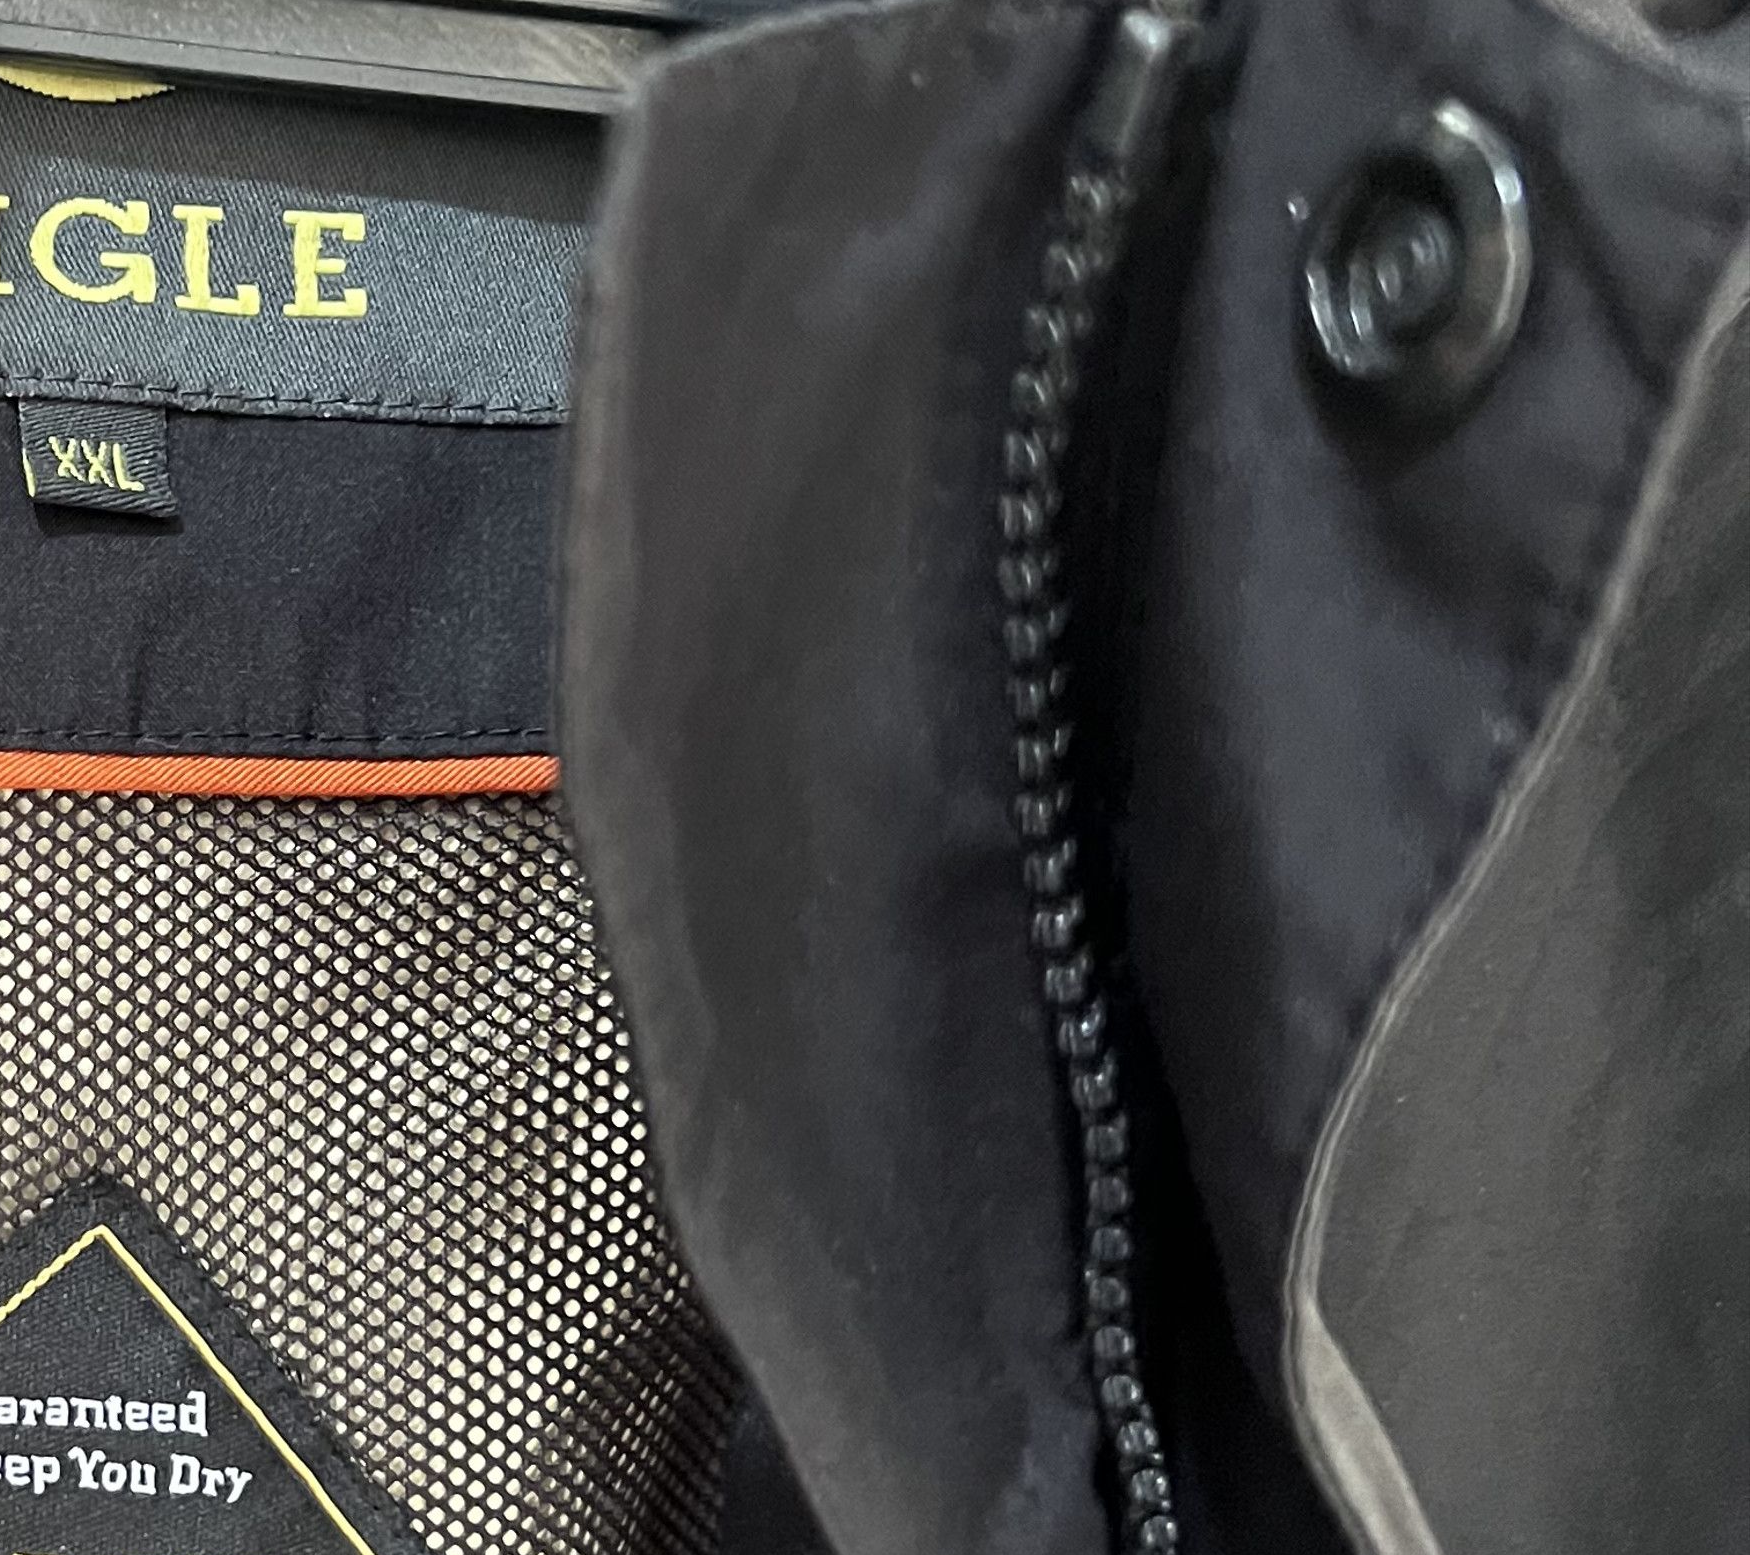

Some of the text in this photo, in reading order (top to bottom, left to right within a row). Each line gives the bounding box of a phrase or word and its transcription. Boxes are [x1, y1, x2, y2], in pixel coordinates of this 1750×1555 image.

[48, 436, 145, 492] XXL
[68, 1445, 157, 1495] You
[169, 1452, 253, 1504] Dry
